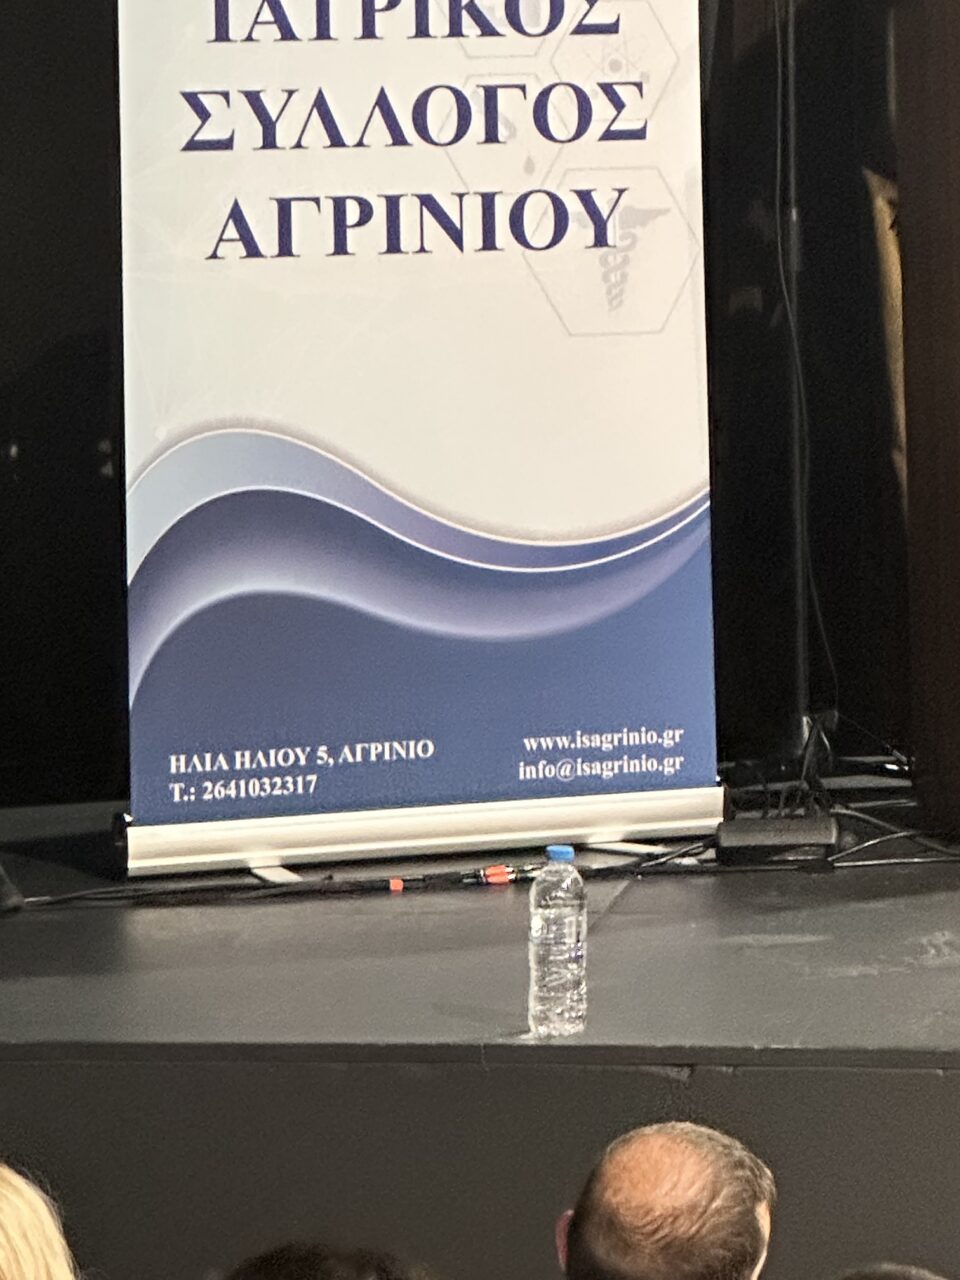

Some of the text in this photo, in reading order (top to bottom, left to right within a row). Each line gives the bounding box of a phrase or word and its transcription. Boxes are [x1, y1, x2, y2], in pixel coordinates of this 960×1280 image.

[179, 81, 648, 152] ΣΥΛΛΟΓΟΣ
[205, 187, 629, 260] ΑΓΡΙΝΙΟΥ
[523, 726, 684, 752] www.isagrinio.gr
[169, 739, 435, 774] ΗΛΙΑ ΗΛΙΟΥ 5, ΑΓΡΙΝΙΟ
[518, 754, 684, 782] info@isagrinio.gr
[202, 774, 318, 801] 2641032317
